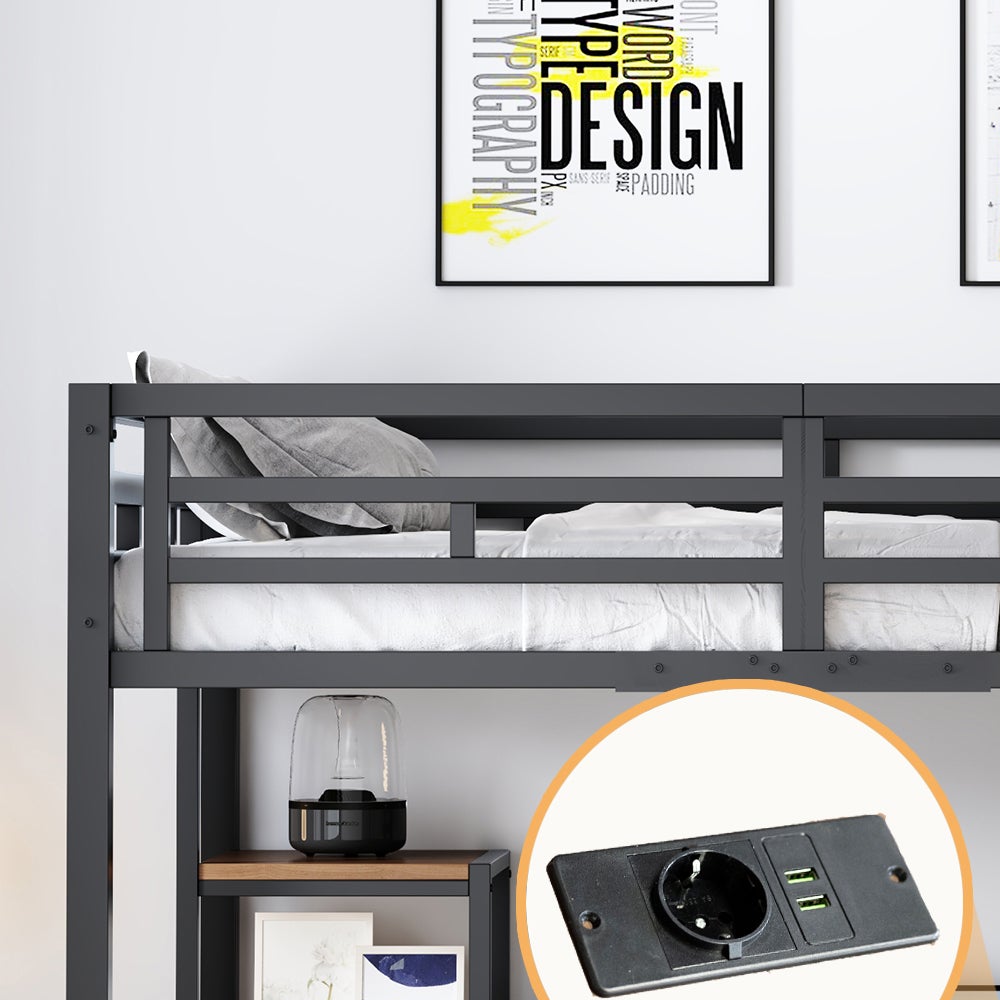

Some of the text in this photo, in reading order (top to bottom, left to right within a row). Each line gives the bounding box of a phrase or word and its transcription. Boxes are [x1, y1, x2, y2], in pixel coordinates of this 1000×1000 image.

[623, 5, 674, 79] WORD
[473, 14, 537, 216] TYPOGRAPHY
[540, 82, 743, 170] DESIGN
[541, 173, 567, 189] PX
[631, 173, 695, 195] PADDING
